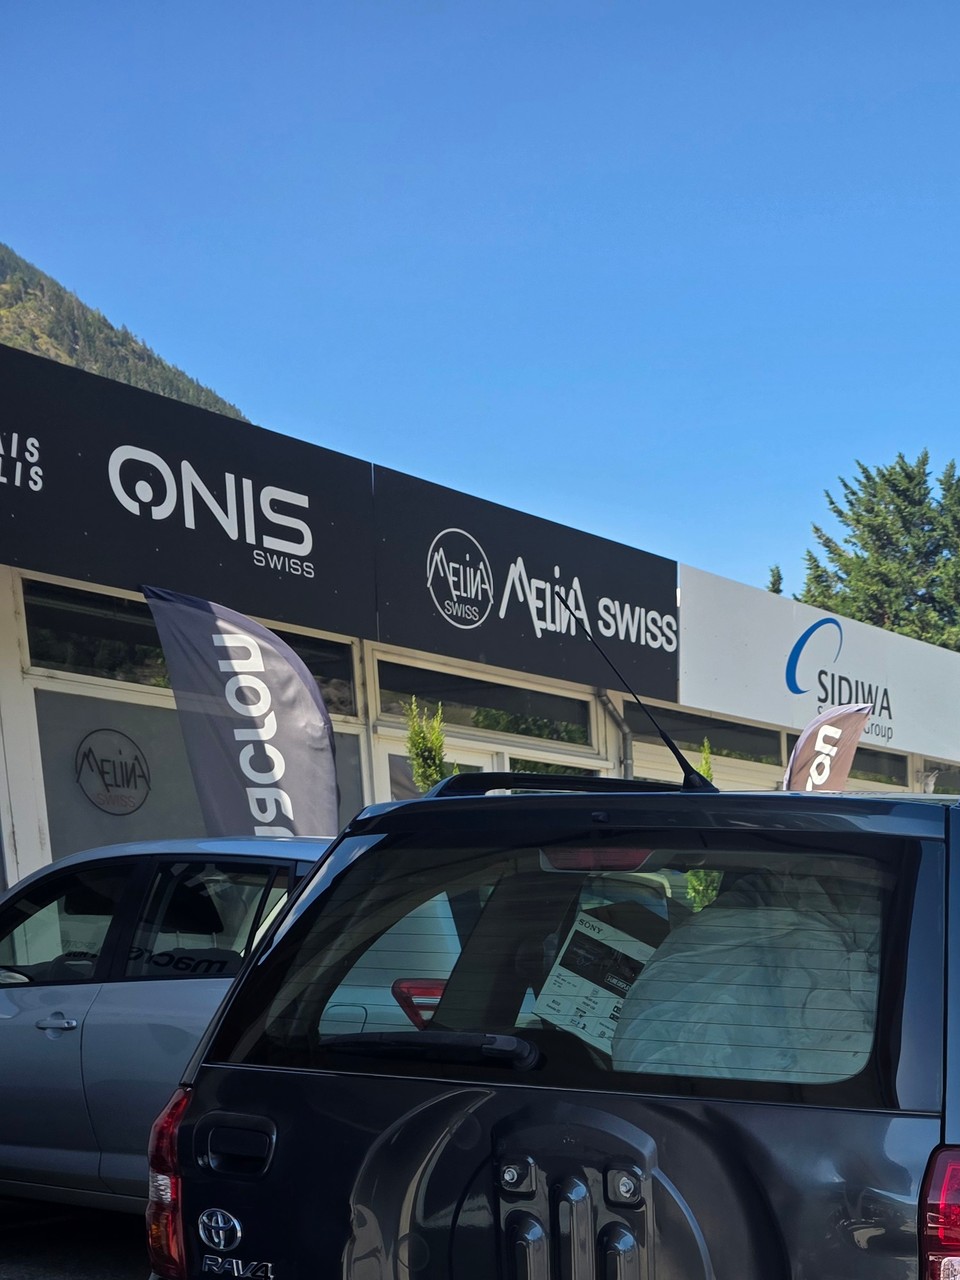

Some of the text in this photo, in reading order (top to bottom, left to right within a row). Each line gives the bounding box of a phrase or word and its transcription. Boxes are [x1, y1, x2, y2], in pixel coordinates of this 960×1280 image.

[108, 445, 313, 556] ONIS
[253, 550, 315, 578] SWISS
[444, 600, 479, 621] SWISS
[598, 597, 678, 652] SWISS
[817, 669, 893, 720] SIDIWA
[97, 792, 136, 809] SWISS
[578, 919, 604, 934] SONY
